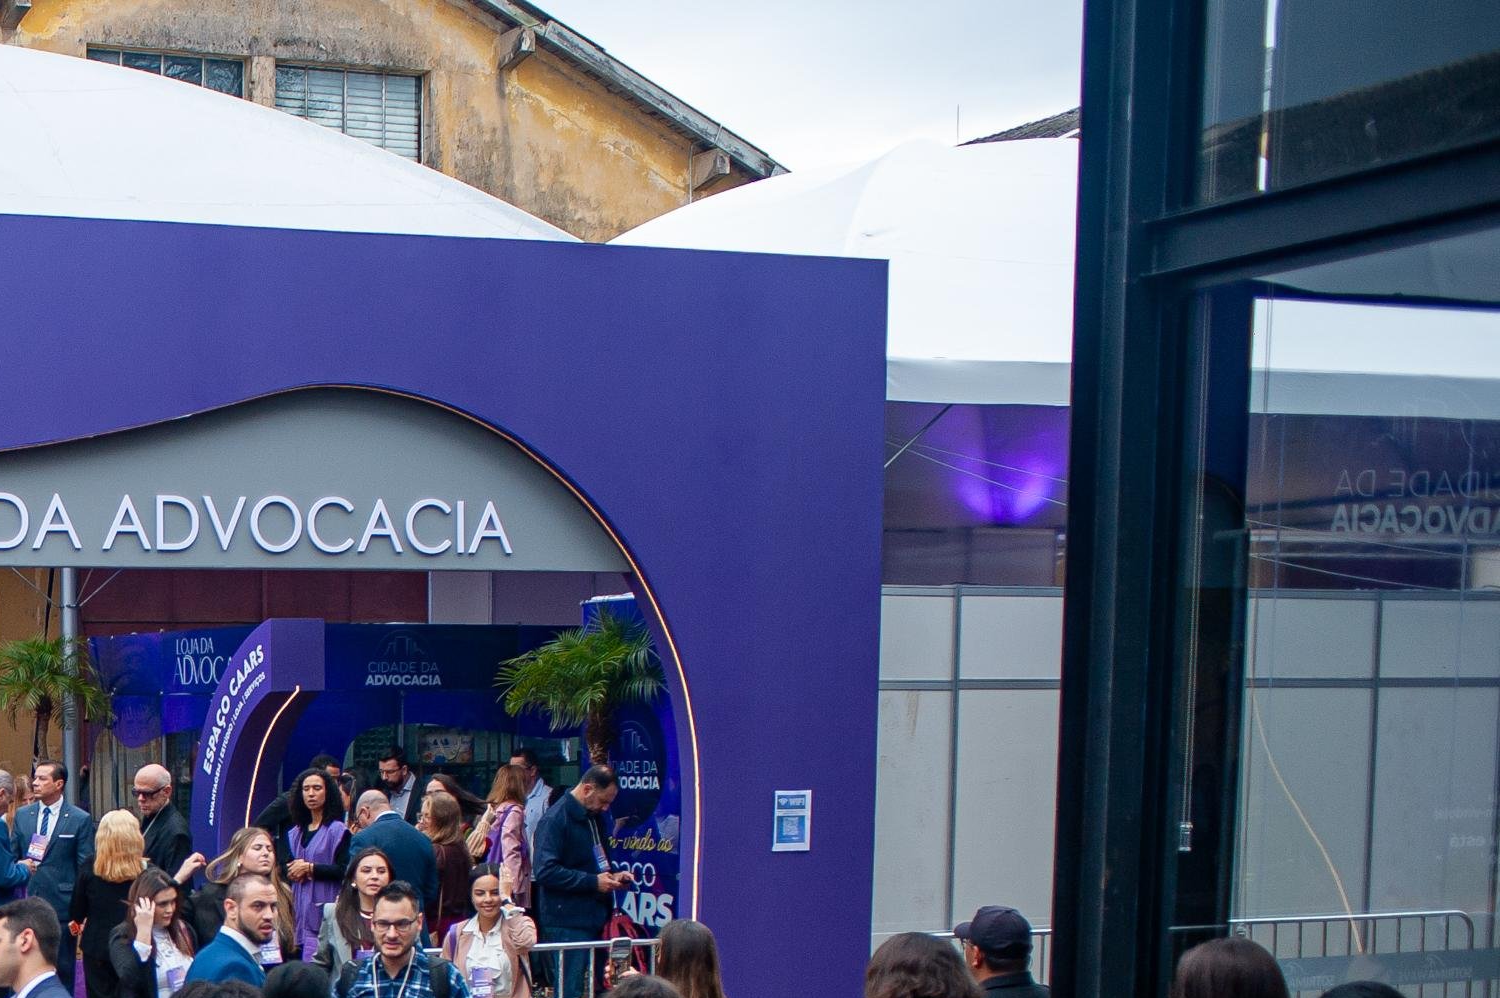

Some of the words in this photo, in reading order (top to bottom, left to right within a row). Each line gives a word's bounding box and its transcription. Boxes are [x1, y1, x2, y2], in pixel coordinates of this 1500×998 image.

[102, 494, 514, 556] ADVOCACIA
[176, 638, 200, 656] LOJA
[200, 636, 214, 655] DA
[368, 661, 418, 673] CIDADE
[421, 662, 440, 673] DA
[365, 674, 442, 686] ADVOCACIA
[202, 695, 231, 775] ESPAÇO
[229, 644, 264, 697] CAARS
